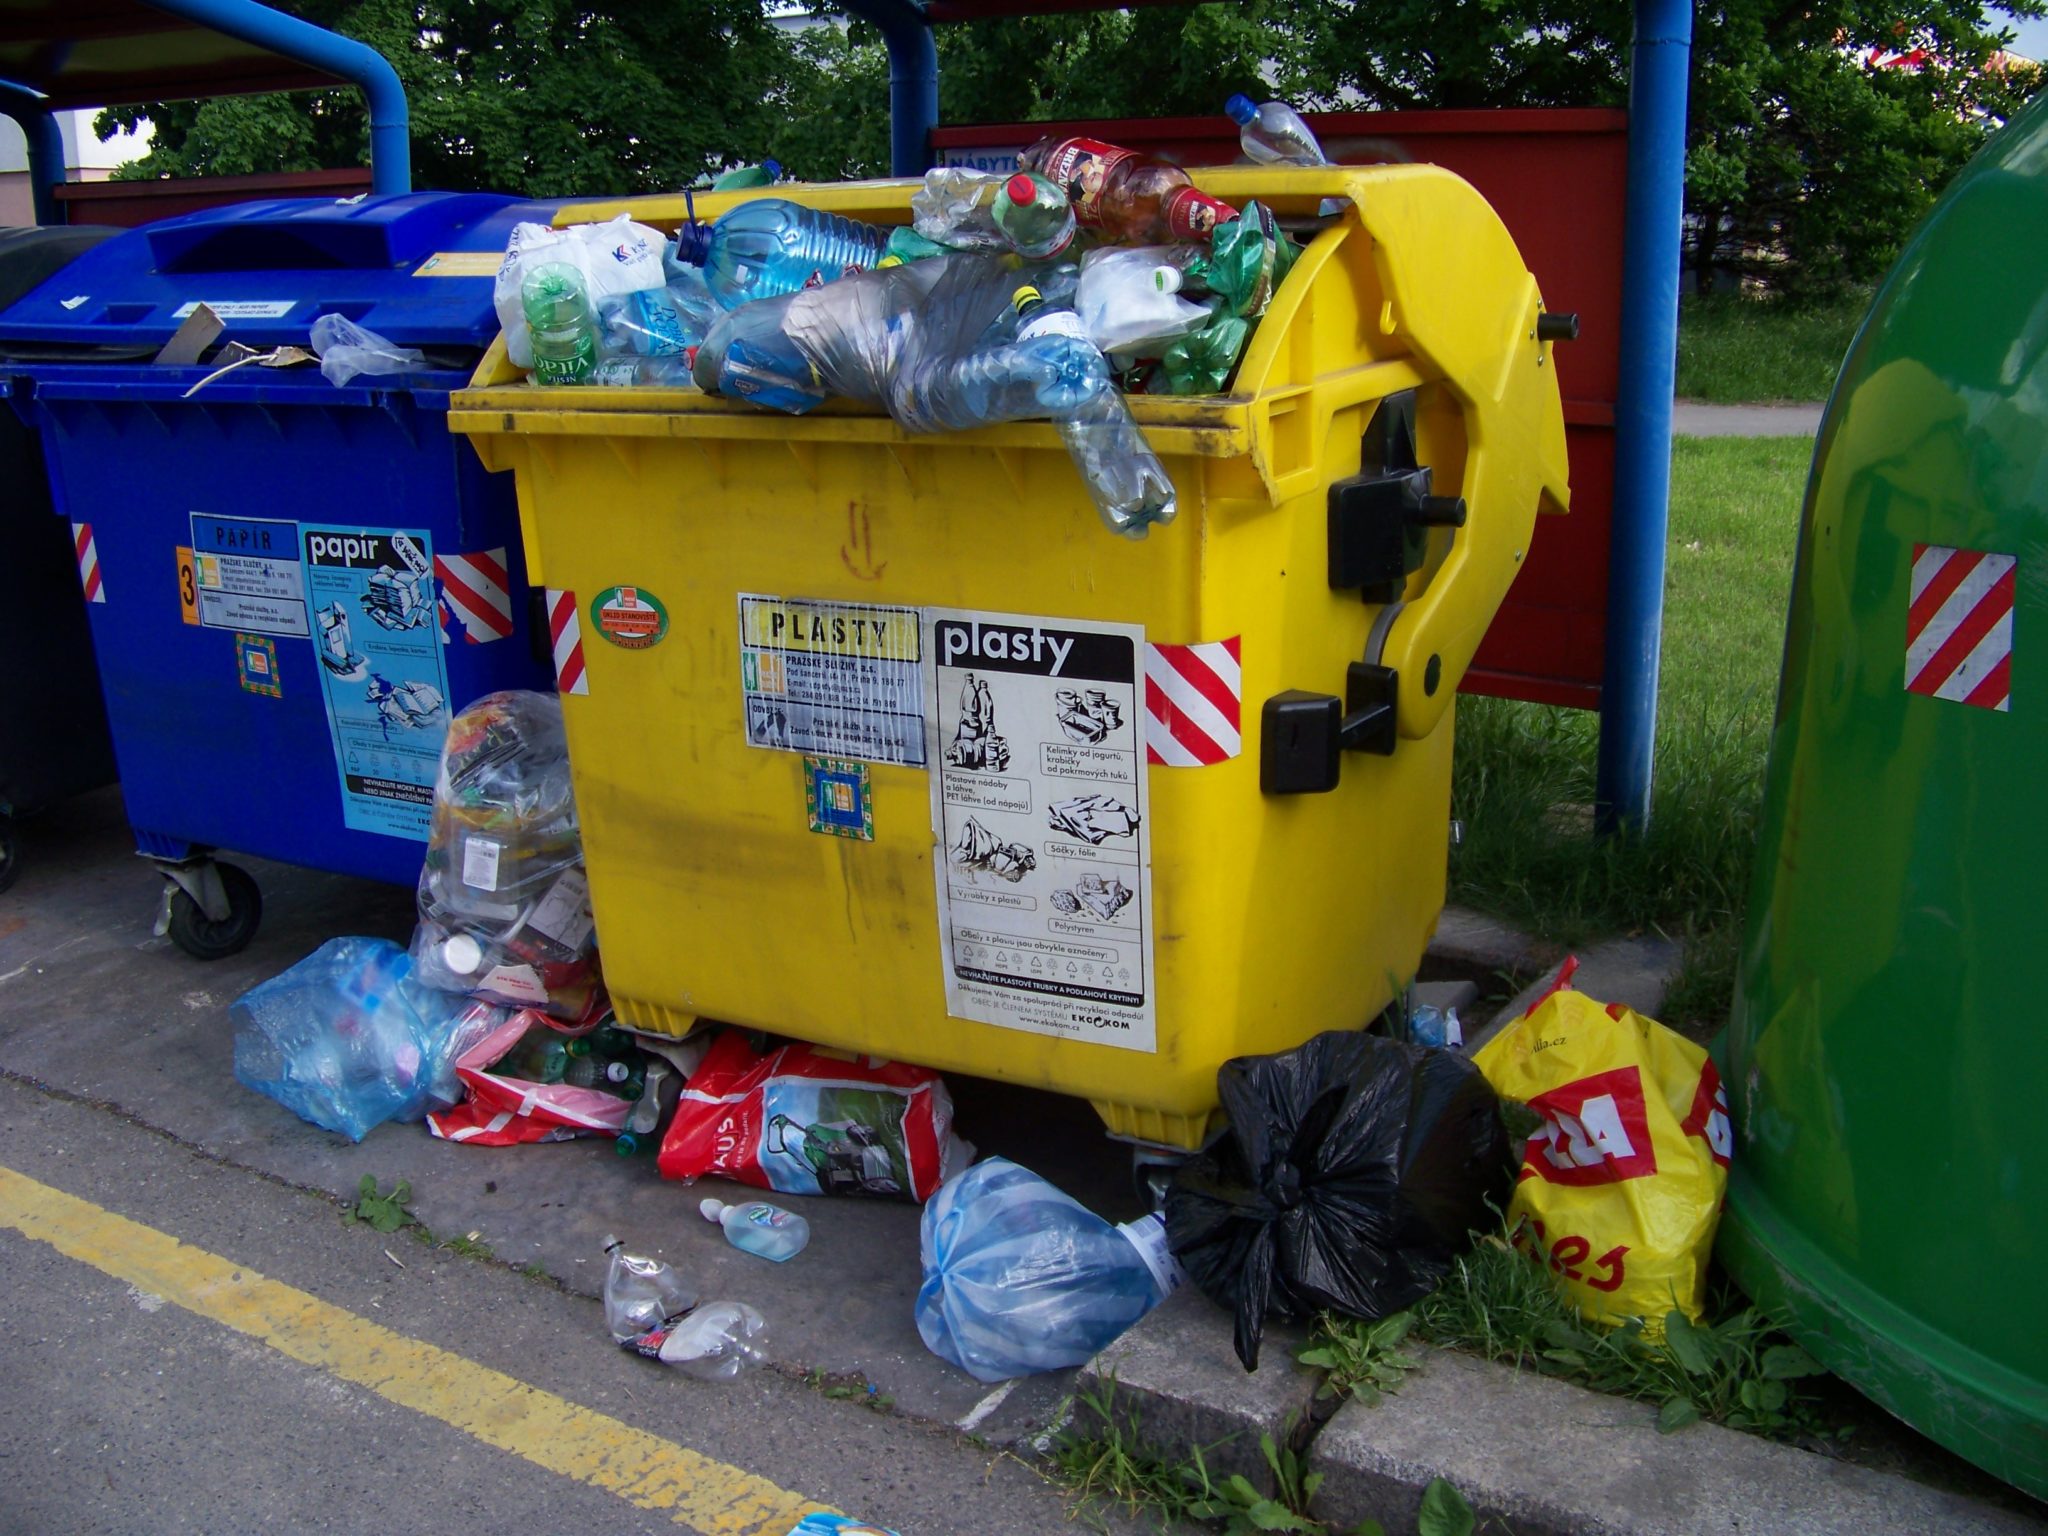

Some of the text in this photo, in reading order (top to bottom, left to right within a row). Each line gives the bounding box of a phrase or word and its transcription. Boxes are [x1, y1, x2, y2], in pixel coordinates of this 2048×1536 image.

[216, 526, 271, 550] PAPÍR
[182, 564, 195, 606] 3
[771, 611, 888, 648] PLASTY
[943, 621, 1074, 677] plasty
[1079, 750, 1091, 758] od
[1047, 765, 1058, 773] od
[945, 773, 1008, 791] Plastové nádoby
[952, 784, 976, 795] láhve,
[946, 792, 1029, 812] PET láhve (od nápojů)
[1050, 844, 1097, 858] Sáčky, fólie
[997, 896, 1022, 906] plastů
[1054, 921, 1096, 934] Polystyren
[1016, 940, 1034, 952] jsou
[1033, 942, 1067, 954] obvykle
[999, 976, 1033, 989] PLASTOVÉ
[1032, 981, 1058, 993] TRUBKY
[1066, 987, 1108, 1000] PODLAHOVÉ
[993, 989, 1012, 999] Vám
[1012, 994, 1022, 1002] za
[1022, 996, 1063, 1009] spolupráci
[1063, 1002, 1075, 1011] při
[1075, 1004, 1110, 1016] recyklaci
[1018, 1015, 1081, 1031] www.ekokom.cz
[1531, 1036, 1567, 1055] illa.cz
